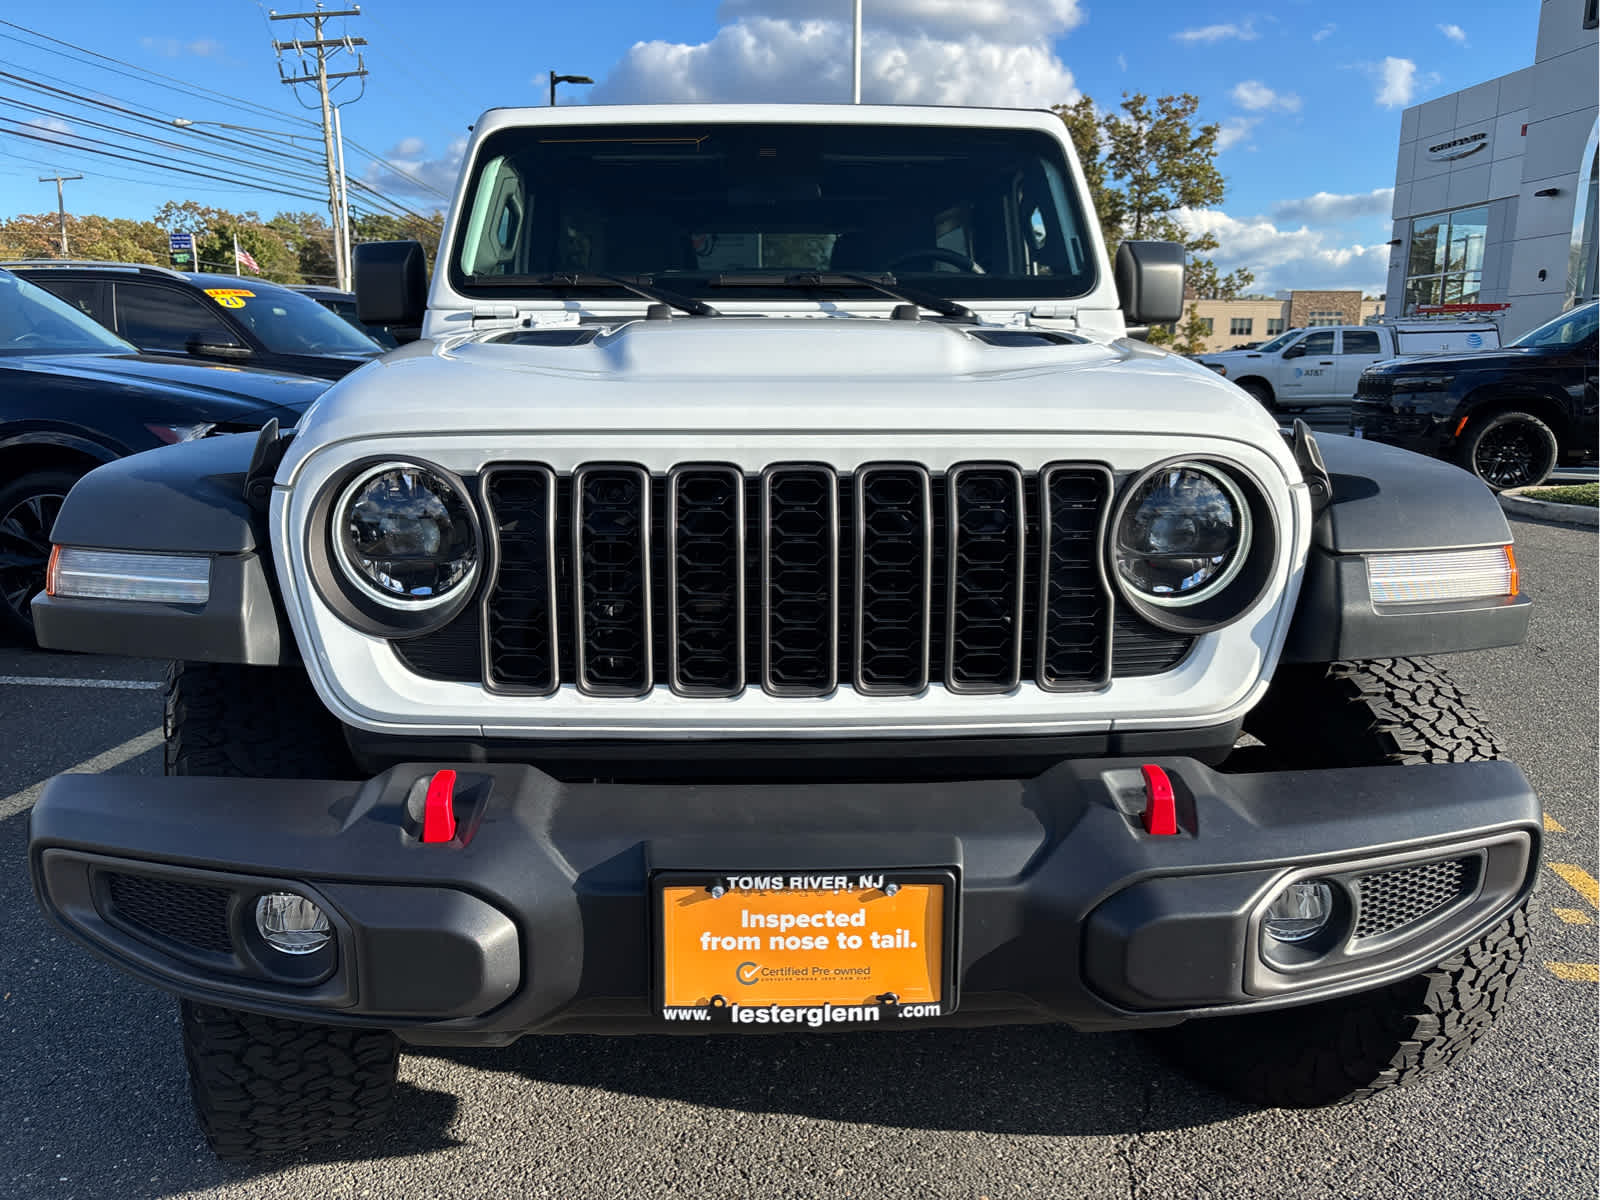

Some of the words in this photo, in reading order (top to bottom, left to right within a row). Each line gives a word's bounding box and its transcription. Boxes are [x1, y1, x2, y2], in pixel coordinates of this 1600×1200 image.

[727, 876, 783, 890] TOMS
[790, 876, 853, 890] RIVER,
[859, 875, 884, 889] NJ
[741, 909, 866, 932] Inspected
[700, 932, 761, 951] from
[769, 934, 829, 950] nose
[836, 932, 862, 950] to
[870, 929, 917, 949] tail.
[761, 966, 808, 977] Certified
[663, 1007, 711, 1021] www.
[731, 1002, 880, 1027] lesterglenn
[898, 1003, 941, 1018] .com
